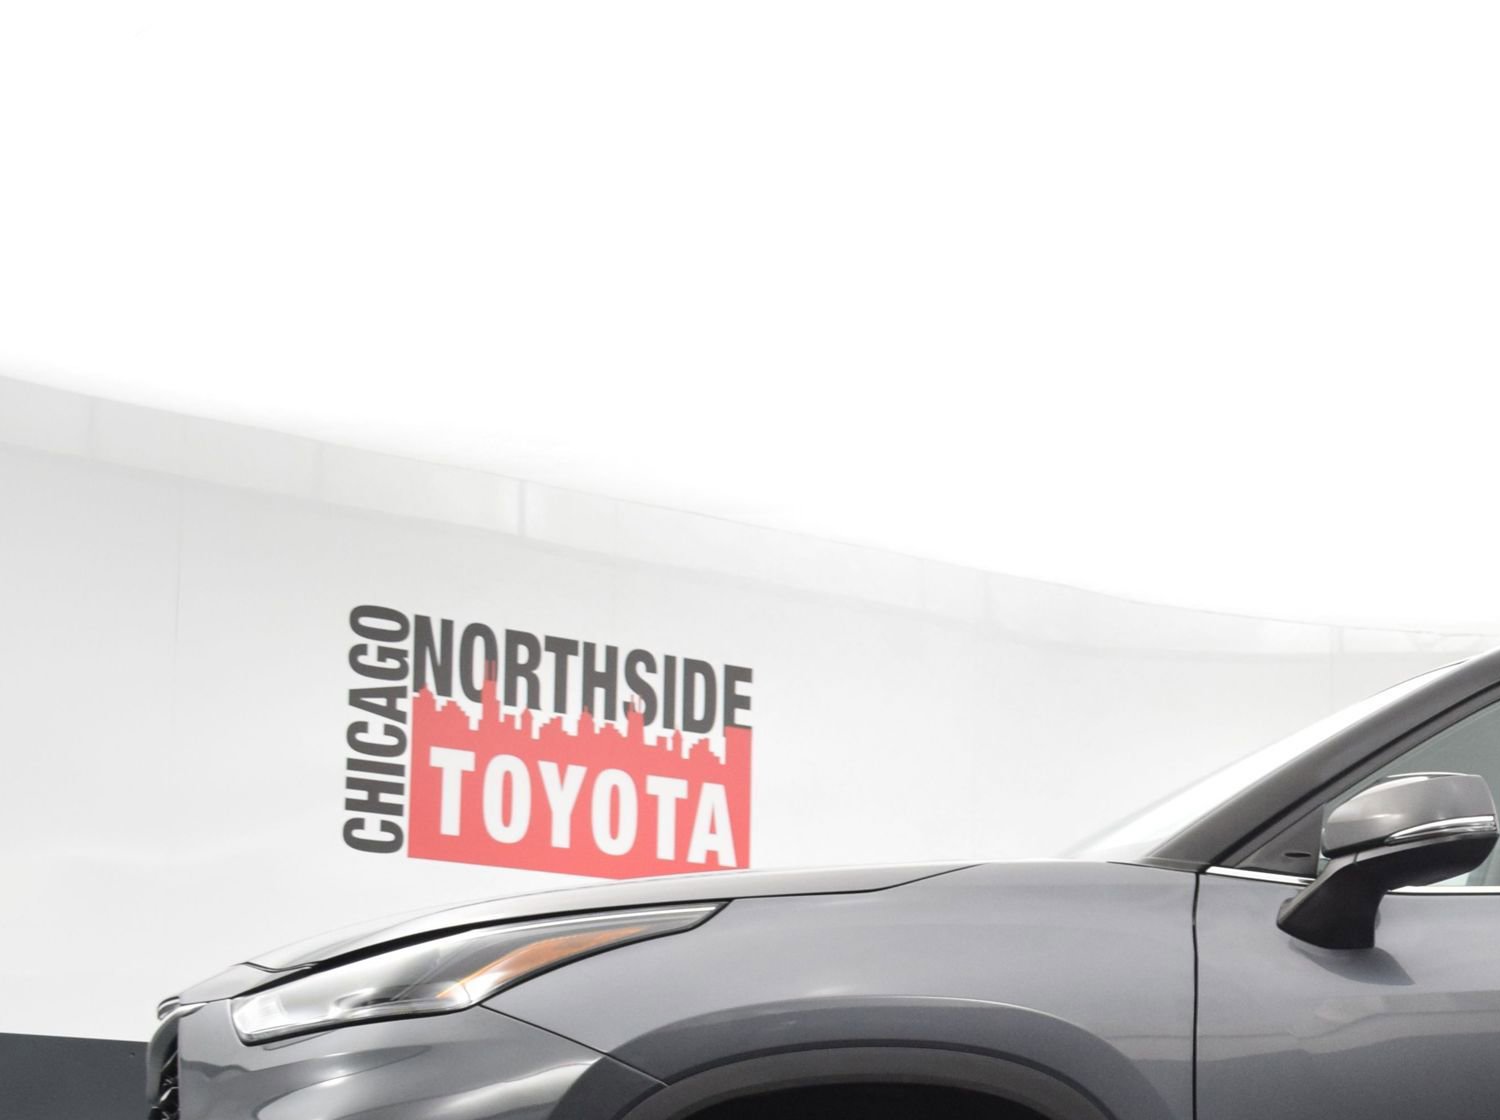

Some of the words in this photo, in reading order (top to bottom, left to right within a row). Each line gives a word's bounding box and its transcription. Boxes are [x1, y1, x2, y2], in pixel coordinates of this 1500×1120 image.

[343, 604, 410, 854] CHICAGO
[412, 614, 753, 735] NORTHSIDE
[429, 745, 737, 868] TOYOTA
